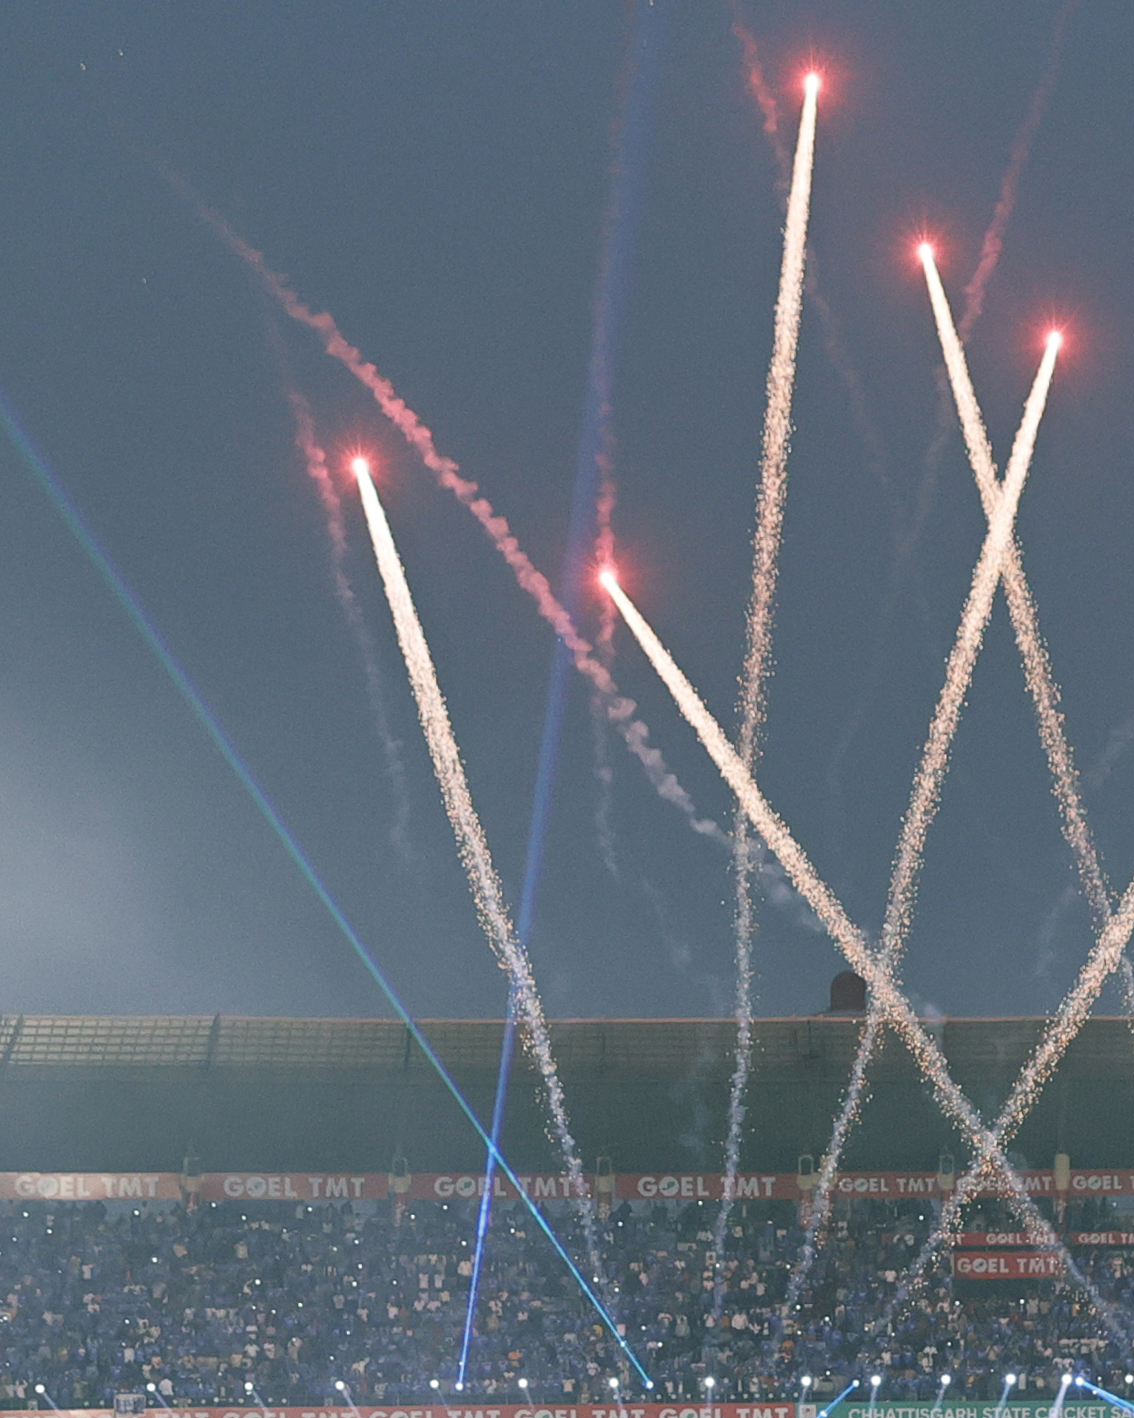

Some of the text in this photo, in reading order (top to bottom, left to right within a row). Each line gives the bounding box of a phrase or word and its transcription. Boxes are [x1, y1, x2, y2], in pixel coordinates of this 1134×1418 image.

[15, 1176, 160, 1198] GOEL TMT
[223, 1176, 365, 1198] GOEL TMT
[637, 1176, 710, 1197] GOEL
[838, 1177, 935, 1192] GOEL TMT
[1072, 1175, 1123, 1190] GOEL
[986, 1233, 1023, 1244] GOEL
[1078, 1233, 1116, 1244] GOEL
[957, 1257, 1056, 1273] GOEL TMT
